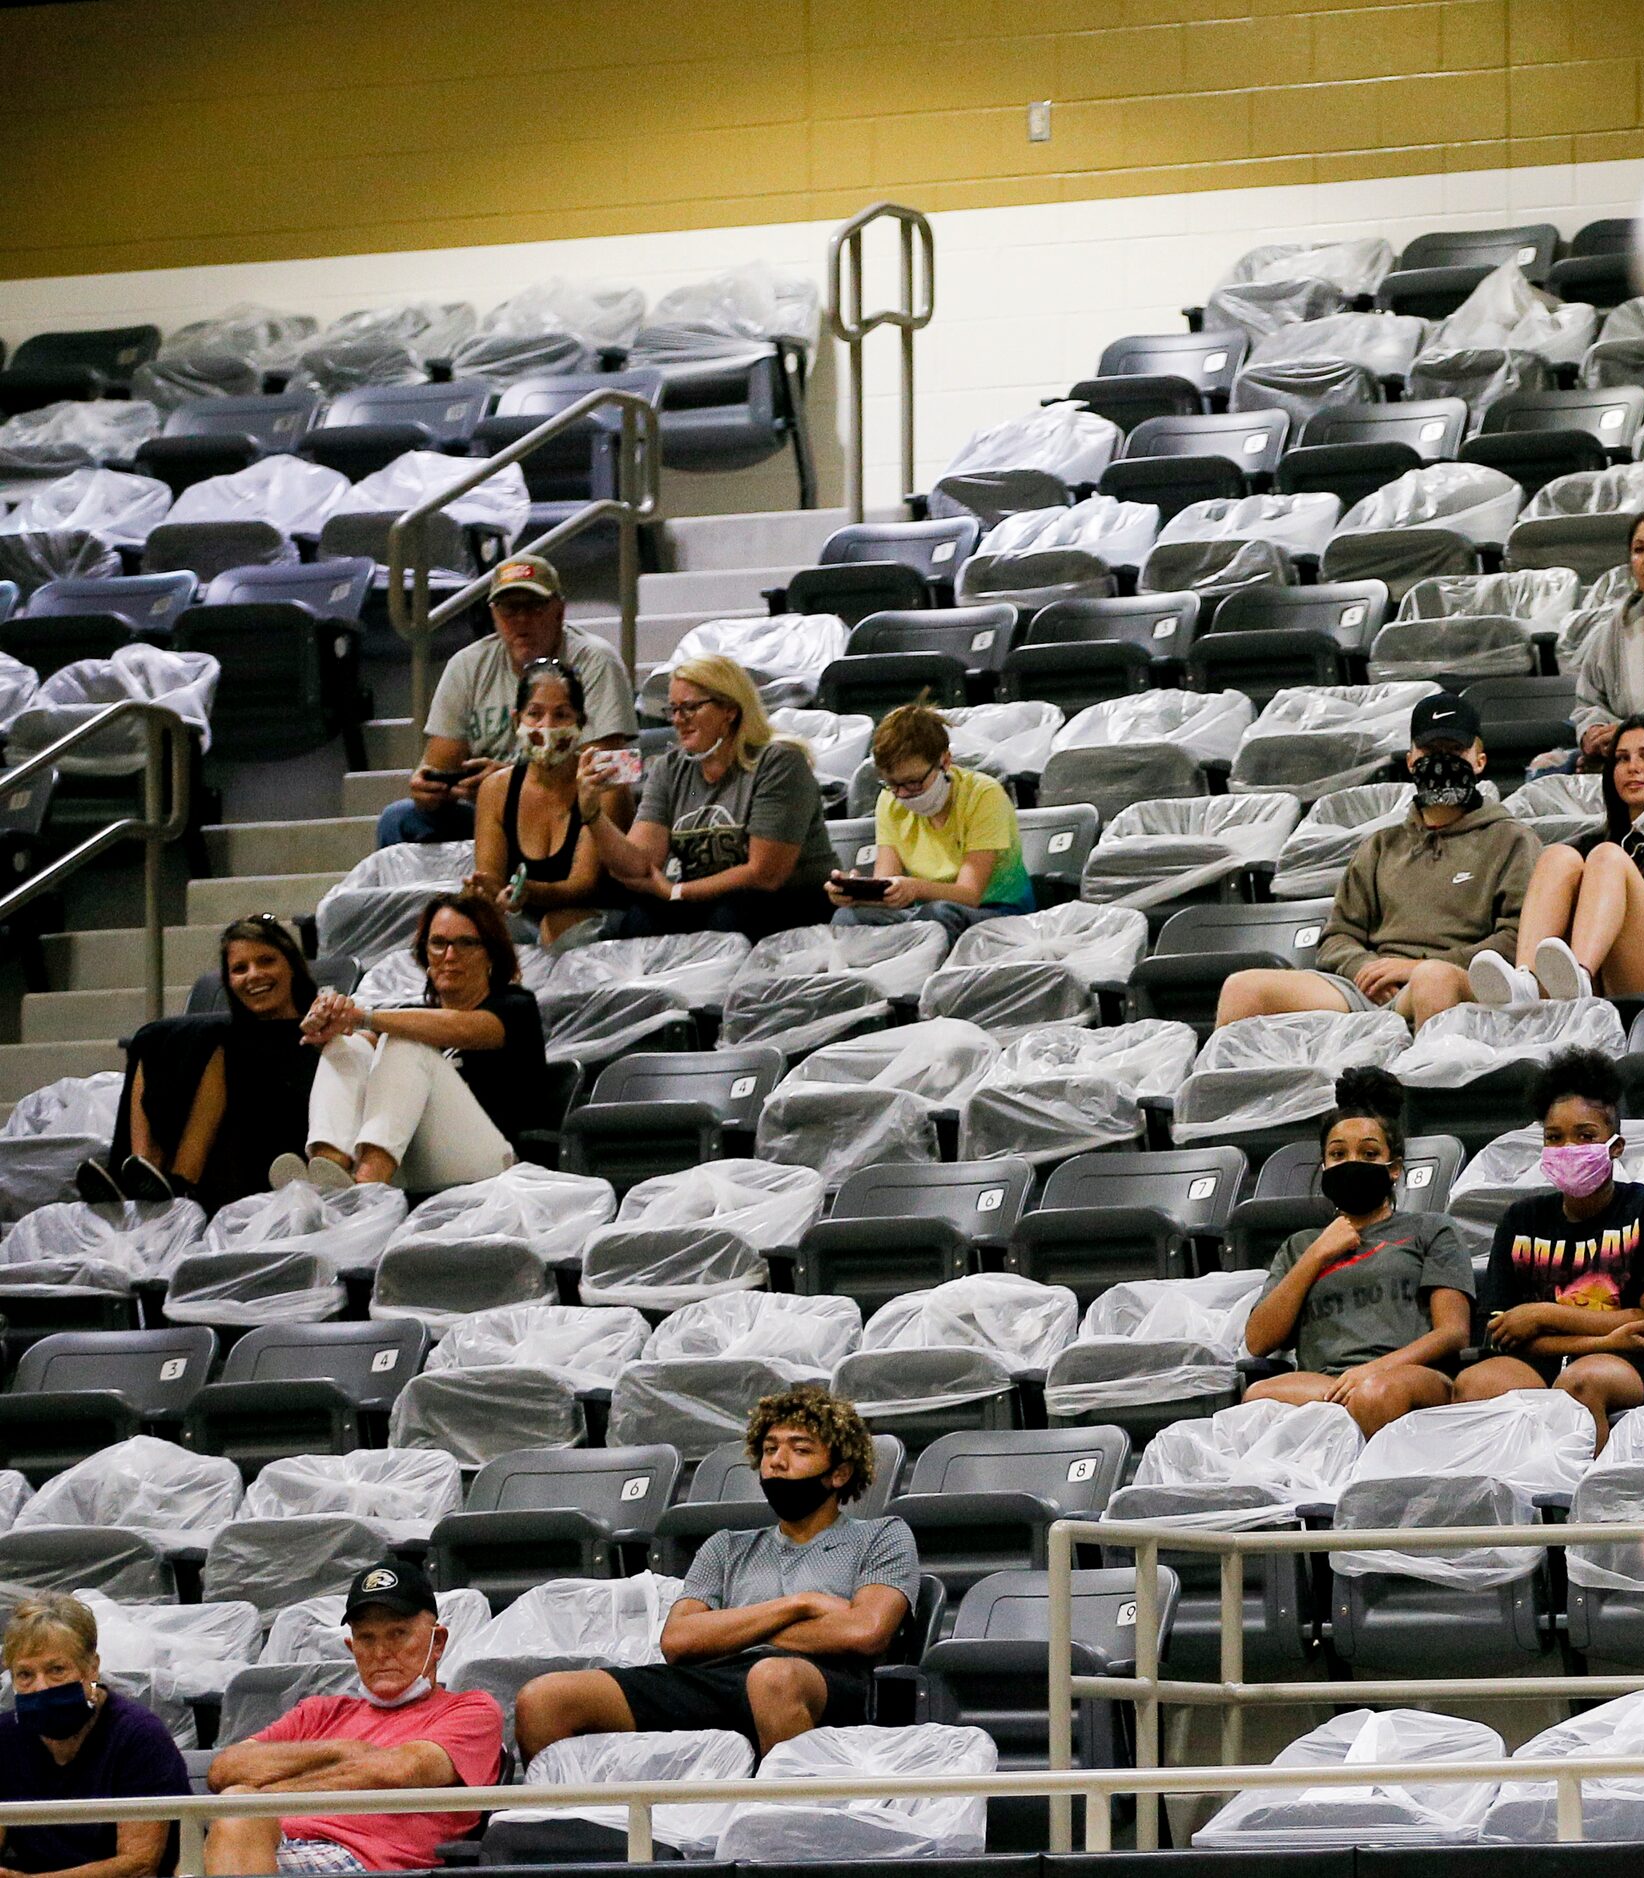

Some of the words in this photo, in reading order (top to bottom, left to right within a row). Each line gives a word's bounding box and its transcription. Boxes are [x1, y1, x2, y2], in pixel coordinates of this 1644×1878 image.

[1302, 930, 1311, 943] 6
[1413, 1171, 1423, 1185] 8
[1198, 1182, 1207, 1196] 7
[985, 1194, 994, 1207] 6
[380, 1354, 389, 1368] 4
[168, 1362, 178, 1377] 3
[1076, 1462, 1086, 1478] 8
[630, 1481, 639, 1496] 6
[1126, 1605, 1136, 1621] 9
